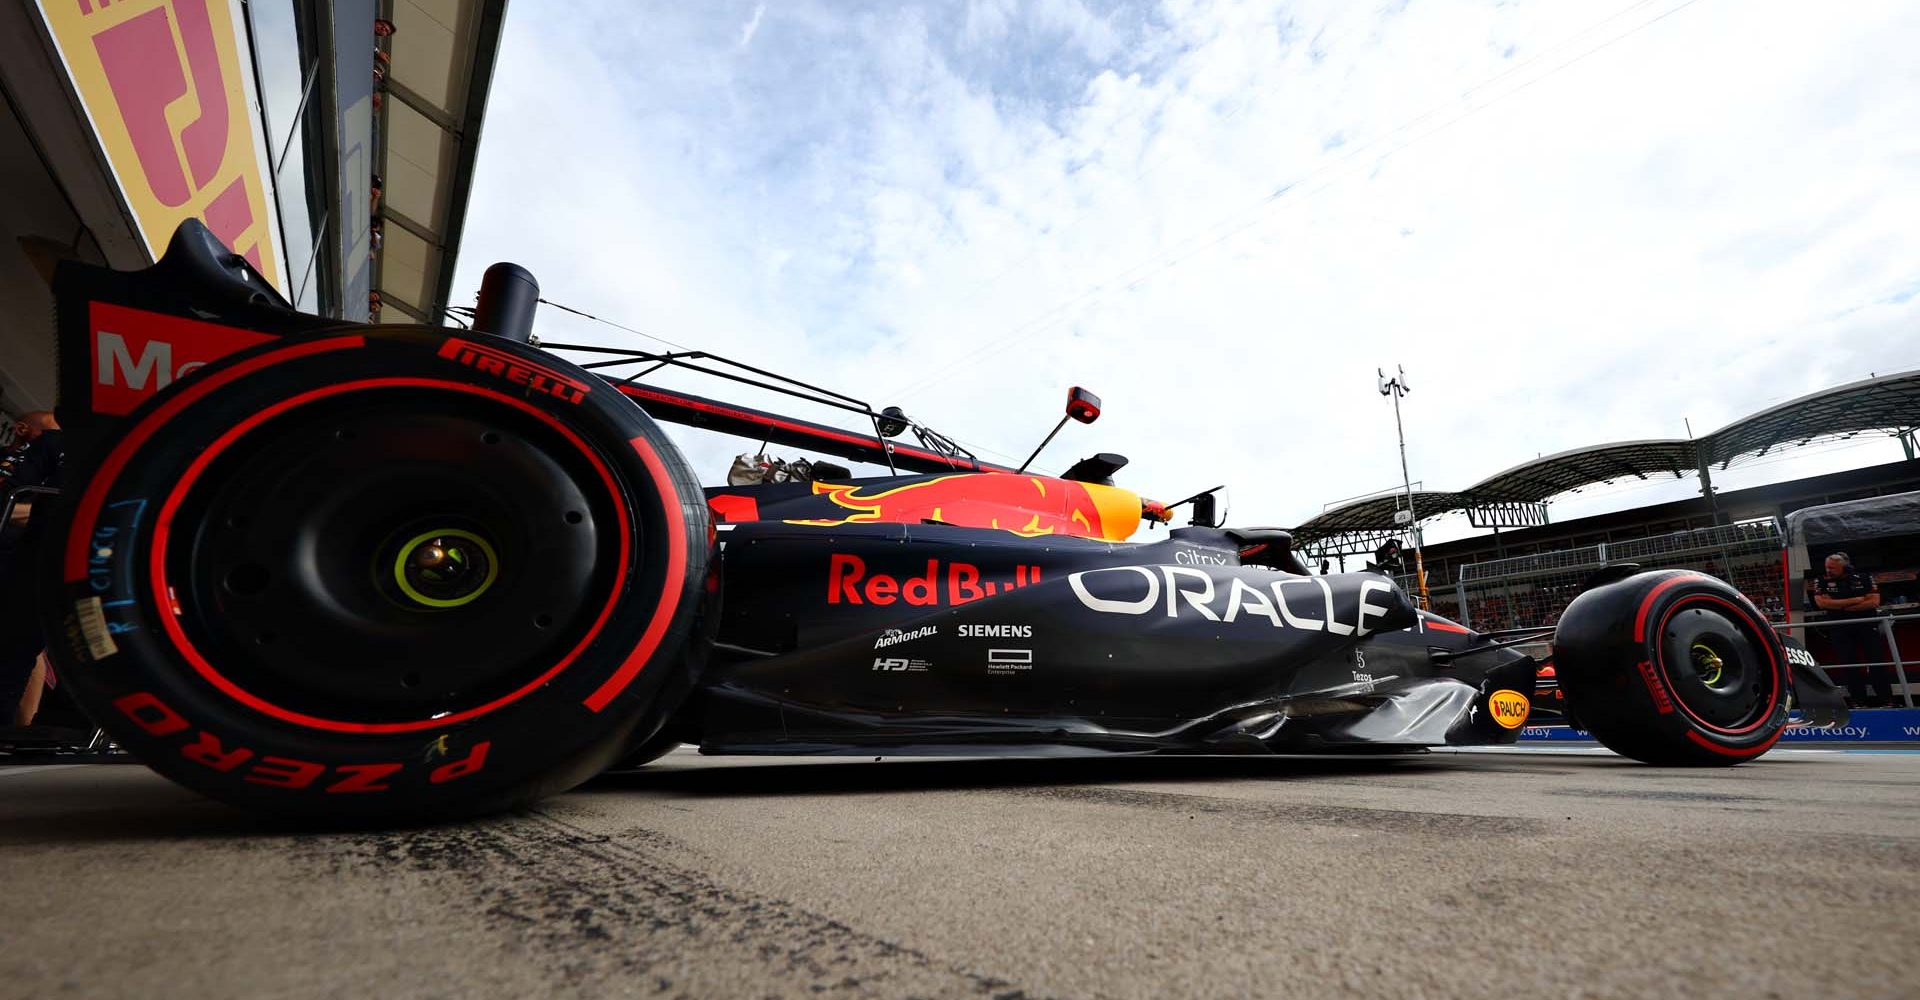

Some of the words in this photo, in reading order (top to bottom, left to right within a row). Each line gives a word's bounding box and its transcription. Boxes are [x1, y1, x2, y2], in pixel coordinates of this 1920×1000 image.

[437, 337, 591, 405] PIRELLI
[828, 554, 938, 606] Red
[1068, 566, 1392, 636] ORACLE
[958, 625, 1032, 637] SIEMENS
[1352, 671, 1372, 682] Tezos
[1499, 701, 1526, 717] RAUCH
[112, 691, 404, 793] ZERO
[430, 740, 491, 783] P
